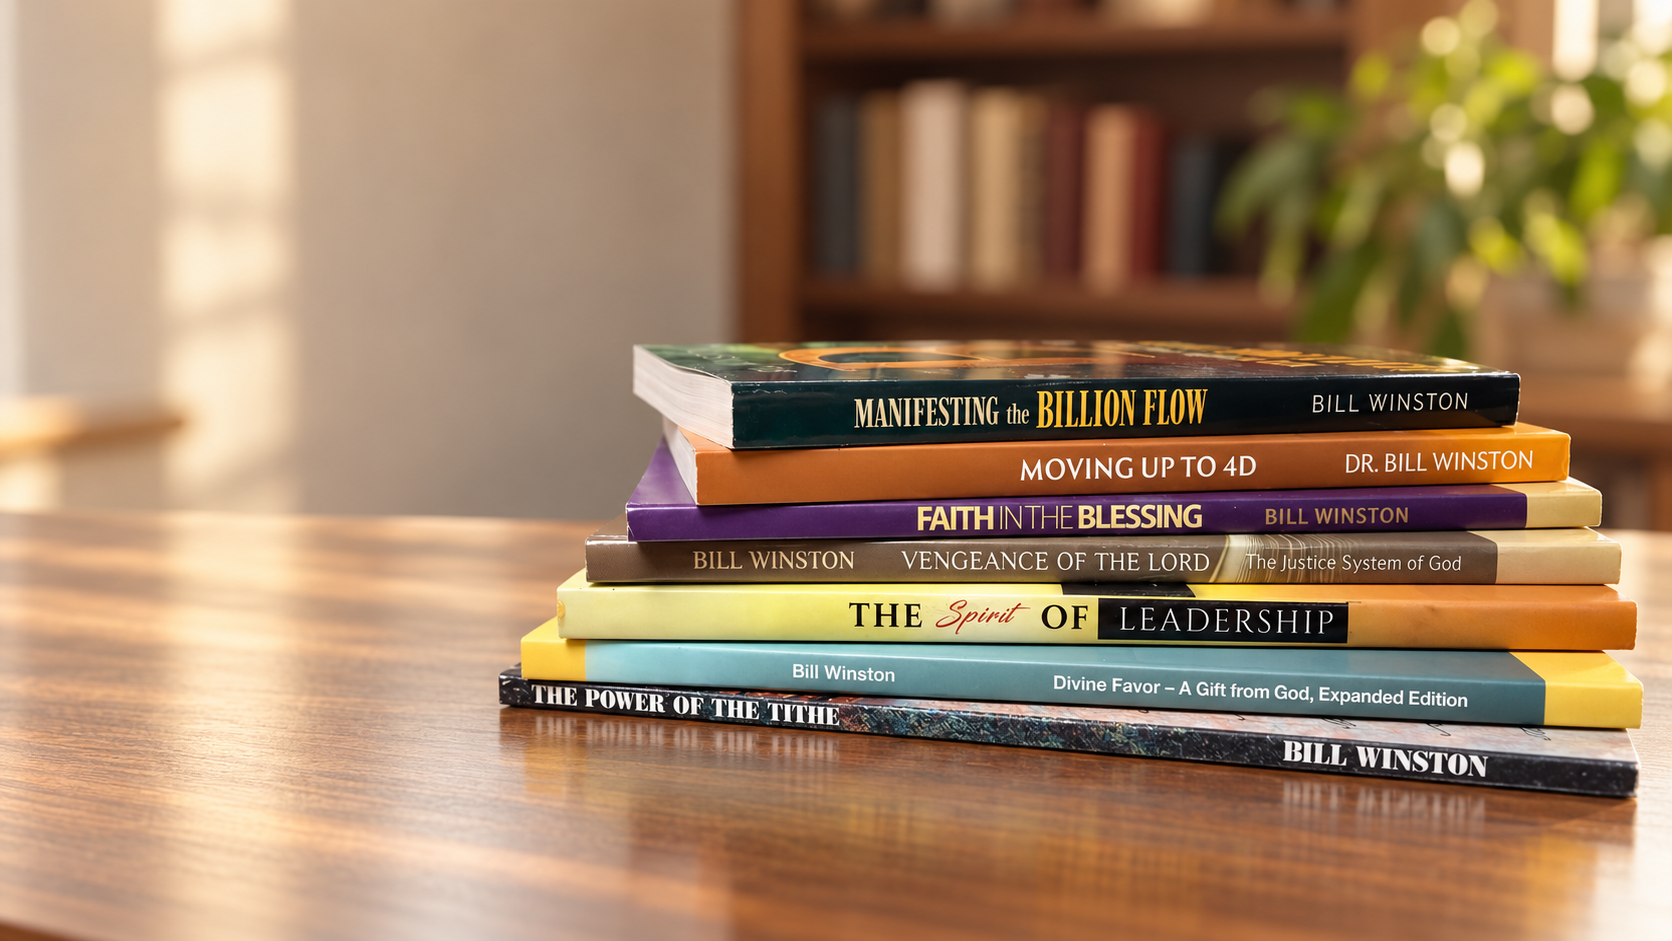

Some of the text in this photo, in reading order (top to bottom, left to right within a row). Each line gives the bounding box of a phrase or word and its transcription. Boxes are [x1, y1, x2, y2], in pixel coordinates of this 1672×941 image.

[854, 388, 1208, 429] MANIFESTING the BILLION FLOW
[1312, 392, 1468, 413] BILL WINSTON
[1020, 455, 1257, 481] MOVING UP TO 4D
[1345, 450, 1534, 474] DR. BILL WINSTON
[917, 506, 994, 531] FAITH
[1078, 504, 1203, 529] BLESSING
[1265, 507, 1409, 525] BILL WINSTON
[692, 550, 855, 571] BILL WINSTON
[901, 550, 1211, 572] VENGEANCE OF THE LORD
[1246, 553, 1462, 574] The Justice System of God
[849, 599, 1335, 635] THE Spirit OF LEADERSHIP
[792, 663, 896, 683] Bill Winston
[1053, 674, 1107, 692] Divine
[1112, 677, 1161, 695] Favor
[1178, 680, 1193, 696] A
[1195, 680, 1228, 698] Gift
[1229, 682, 1270, 699] from
[1273, 684, 1315, 703] God,
[1319, 686, 1404, 707] Expanded
[1408, 690, 1469, 708] Edition
[531, 684, 841, 727] THE POWER OF THE TITHE
[1282, 740, 1489, 778] BILL WINSTON
